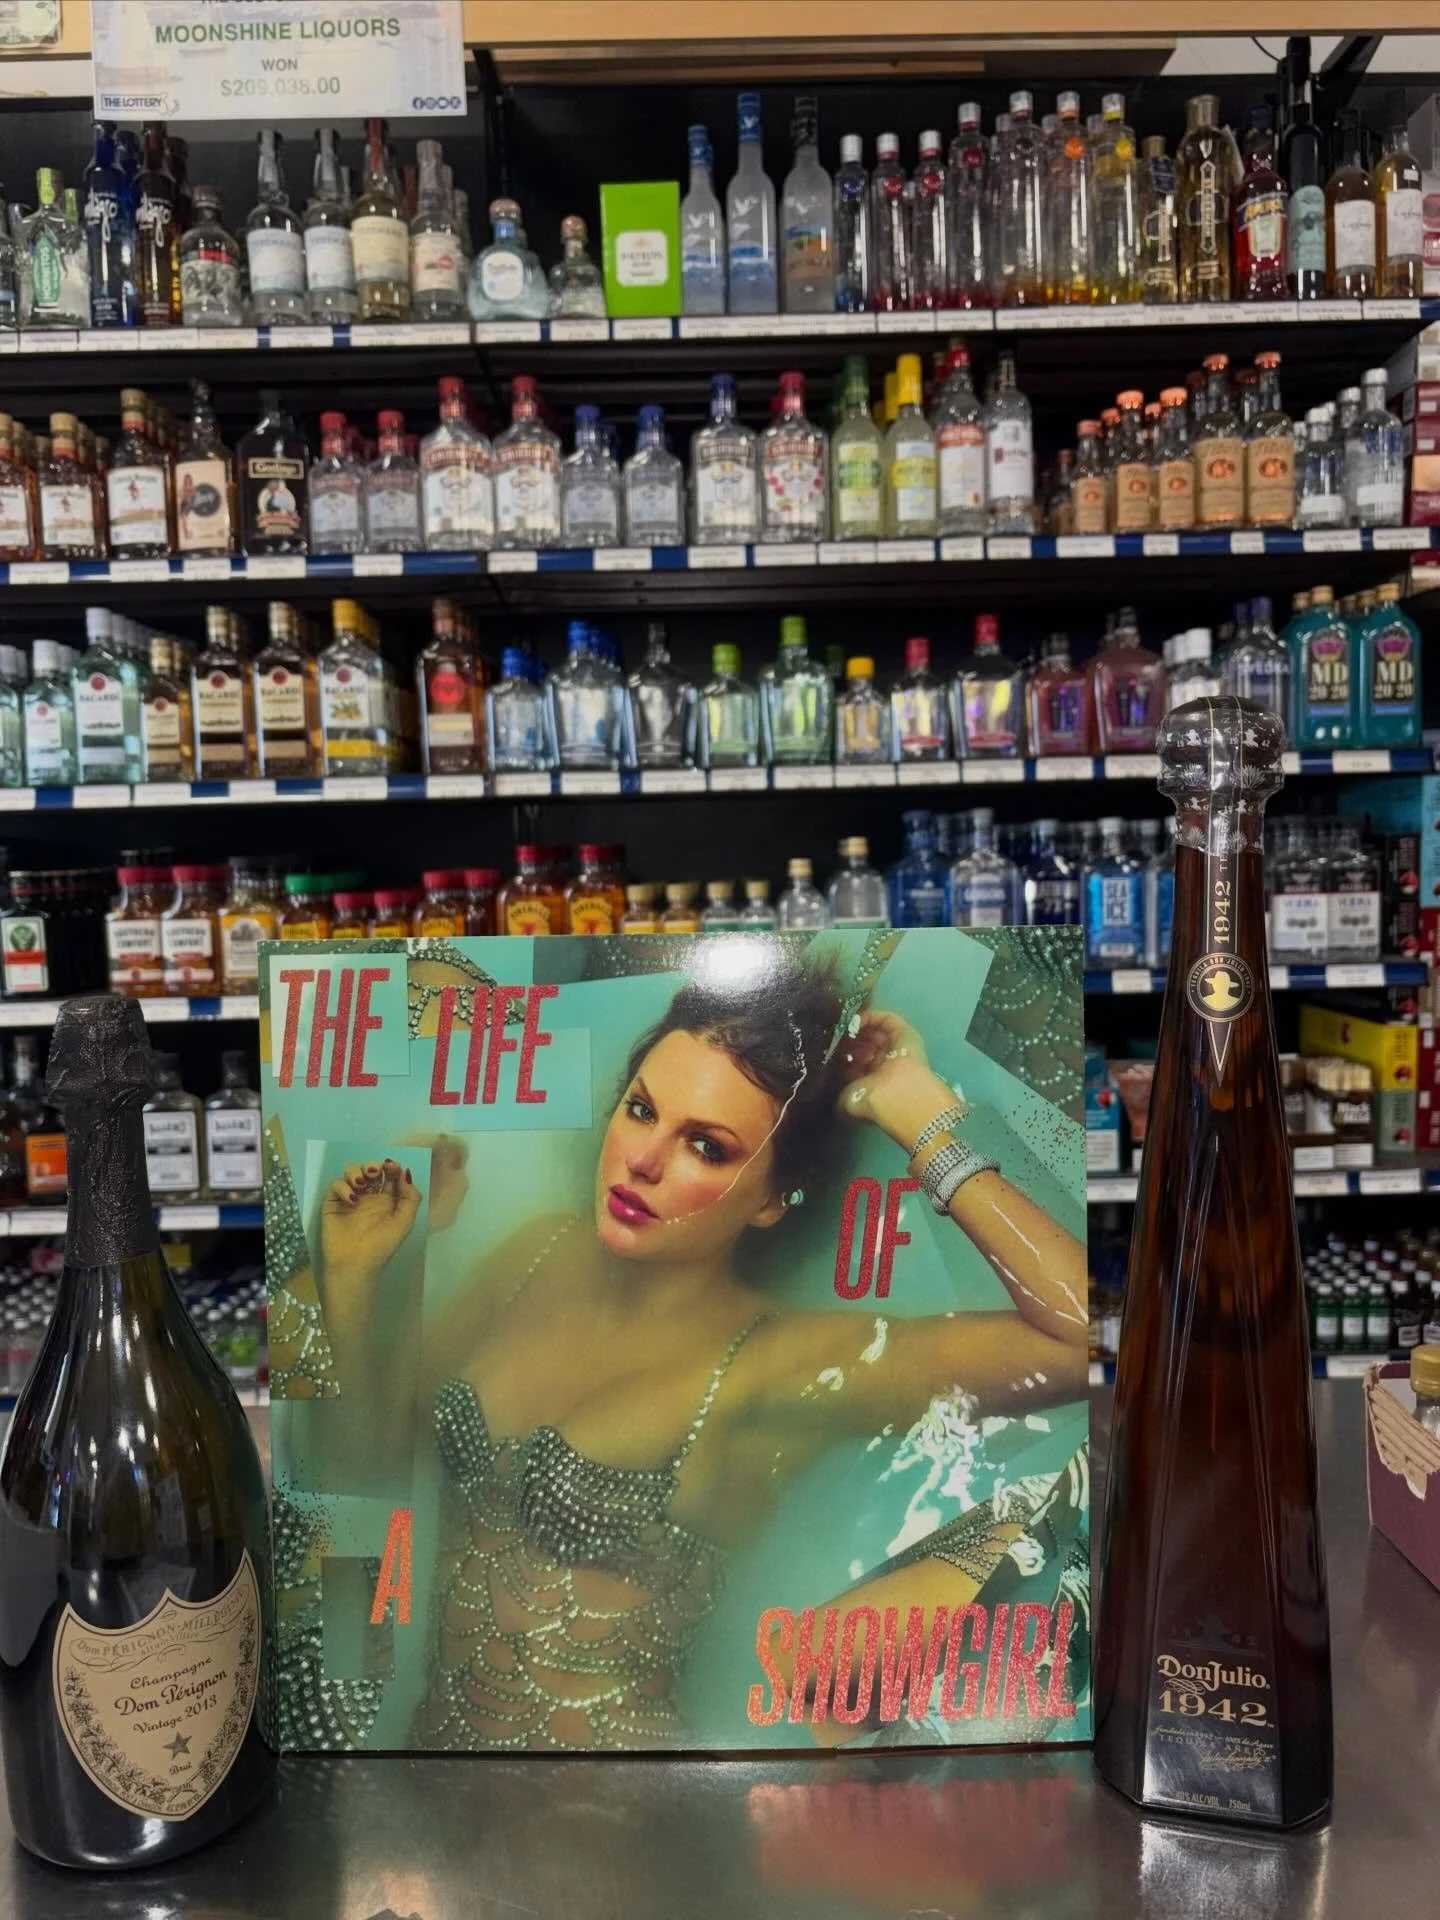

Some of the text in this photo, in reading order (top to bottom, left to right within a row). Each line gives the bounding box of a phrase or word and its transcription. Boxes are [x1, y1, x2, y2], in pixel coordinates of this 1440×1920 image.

[155, 18, 401, 43] MOONSHINE LIQUORS
[261, 58, 299, 72] WON
[103, 97, 162, 108] THE LOTTERY
[1312, 661, 1349, 683] MD
[1376, 661, 1413, 683] MD
[1106, 881, 1127, 899] SEA
[1106, 902, 1127, 921] ICE
[1213, 880, 1231, 944] 1942
[279, 968, 560, 1106] THE LIFE
[833, 1175, 920, 1300] OF
[370, 1508, 413, 1624] A
[130, 1657, 213, 1690] Champagne
[746, 1602, 1077, 1727] SHOWGIRL
[114, 1669, 227, 1716] Dom Pérignon
[1159, 1690, 1268, 1727] 1942
[133, 1694, 217, 1733] Vintage 2013
[169, 1761, 193, 1776] Brut
